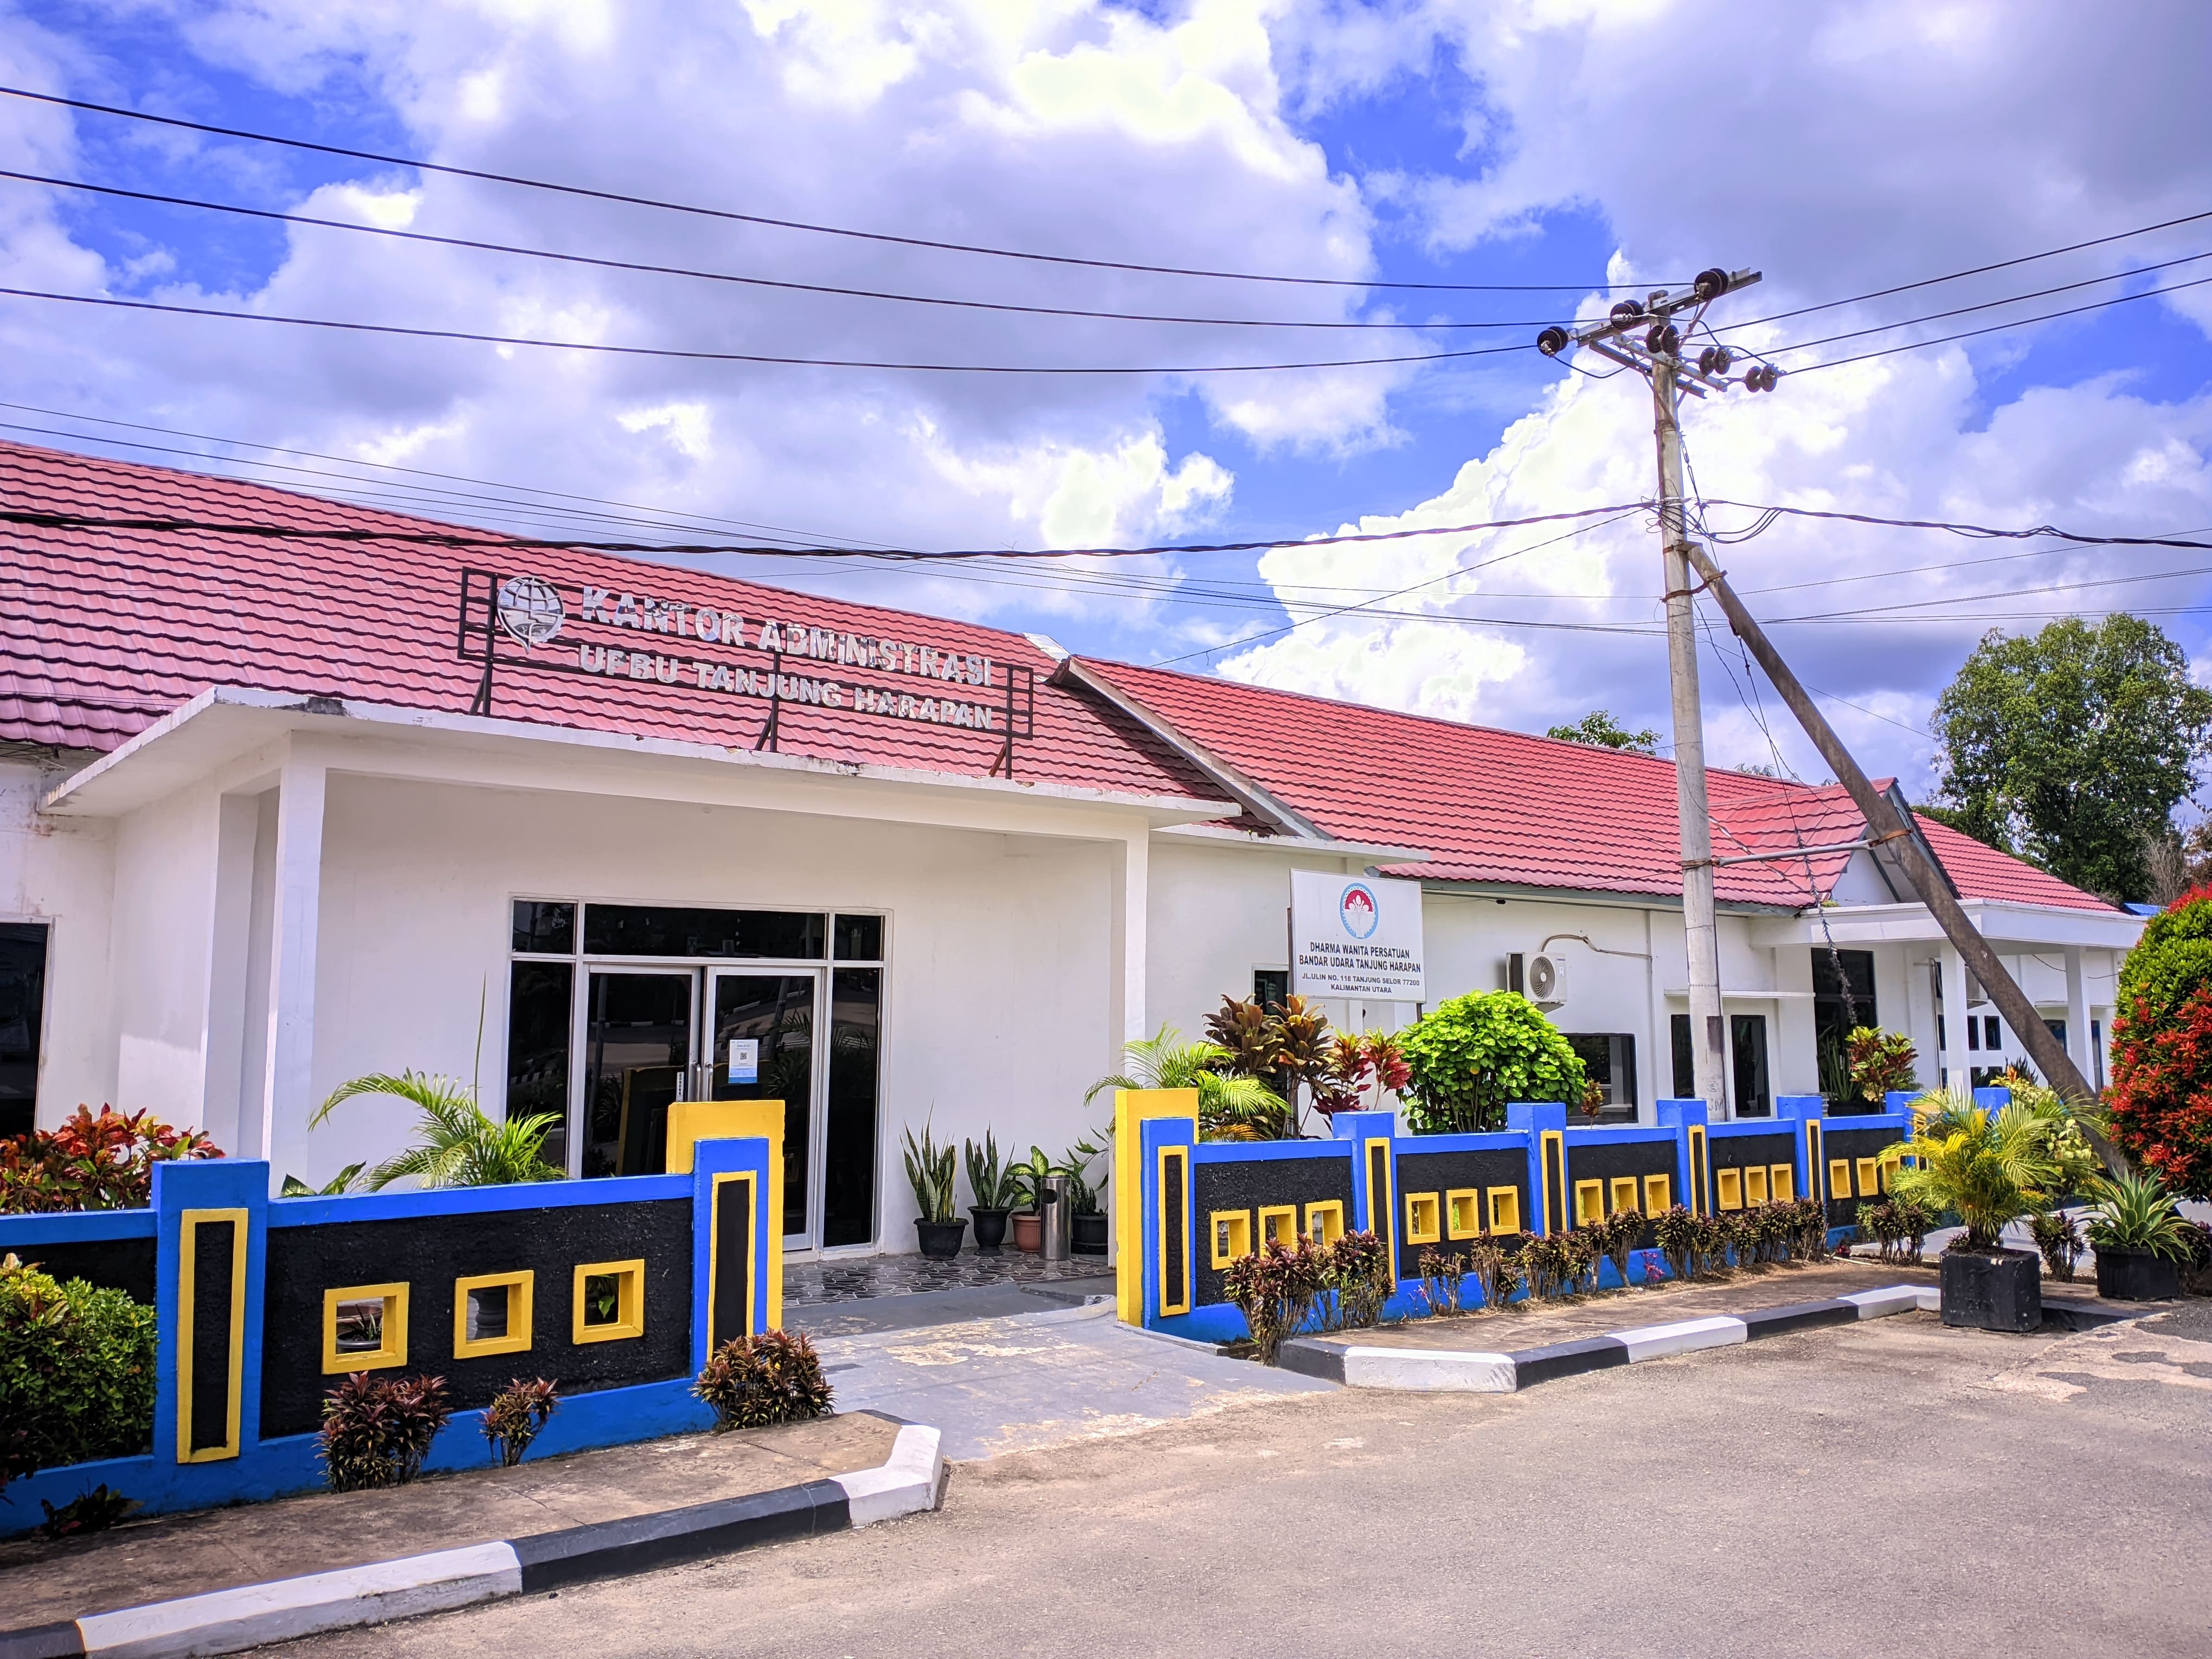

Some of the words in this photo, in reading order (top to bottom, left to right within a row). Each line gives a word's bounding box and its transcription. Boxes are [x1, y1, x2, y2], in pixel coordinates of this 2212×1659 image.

[582, 586, 745, 647] KANTOR
[758, 620, 991, 687] ADMINISTRASI
[579, 645, 678, 684] UPBU
[692, 661, 842, 707] TANJUNG
[853, 687, 992, 730] HARAPAN
[1310, 941, 1341, 954] DHARMA
[1342, 944, 1369, 956] WANITA
[1371, 947, 1410, 959] PERSATUAN
[1299, 955, 1328, 966] BANDAR
[1330, 957, 1354, 968] UDARA
[1356, 959, 1387, 970] TANJUNG
[1390, 961, 1421, 973] HARAPAN
[1330, 983, 1371, 992] KALIMANTAN
